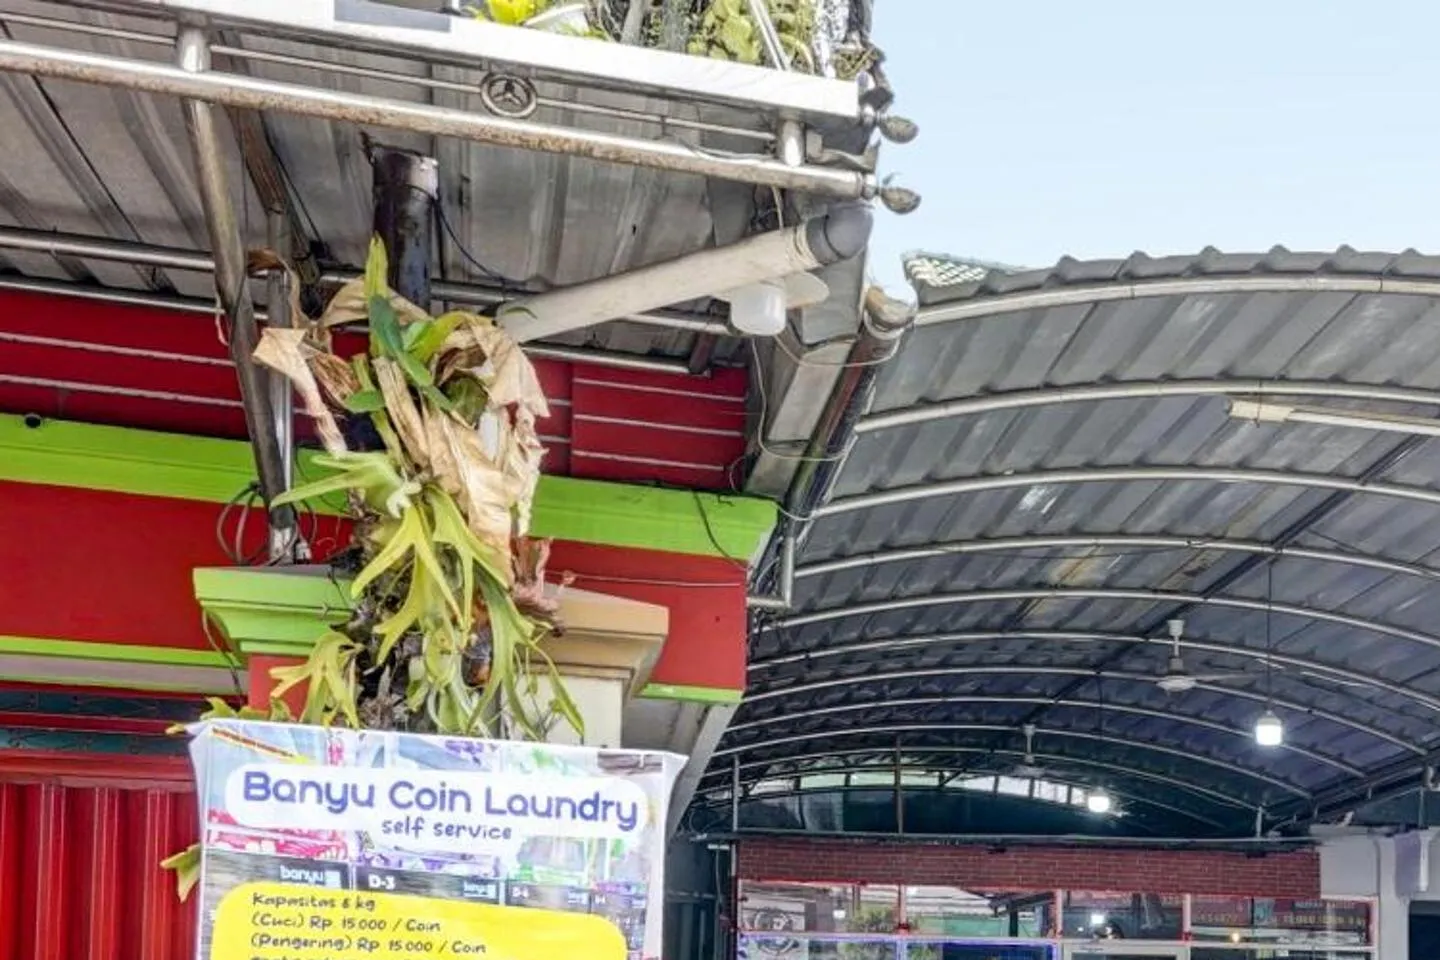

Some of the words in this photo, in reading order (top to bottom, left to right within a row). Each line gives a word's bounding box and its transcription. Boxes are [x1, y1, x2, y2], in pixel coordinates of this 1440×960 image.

[243, 770, 375, 814] Banyu
[388, 780, 472, 813] Coin
[485, 786, 638, 832] Laundry
[382, 815, 426, 839] self
[433, 821, 513, 840] service
[252, 892, 336, 909] Kapasitas
[355, 896, 376, 912] kg
[251, 911, 304, 928] (Cuci)
[310, 915, 333, 931] Rp
[406, 918, 441, 932] Coin
[251, 932, 352, 951] (Pengering)
[357, 936, 380, 953] Rp
[451, 940, 486, 953] Coin
